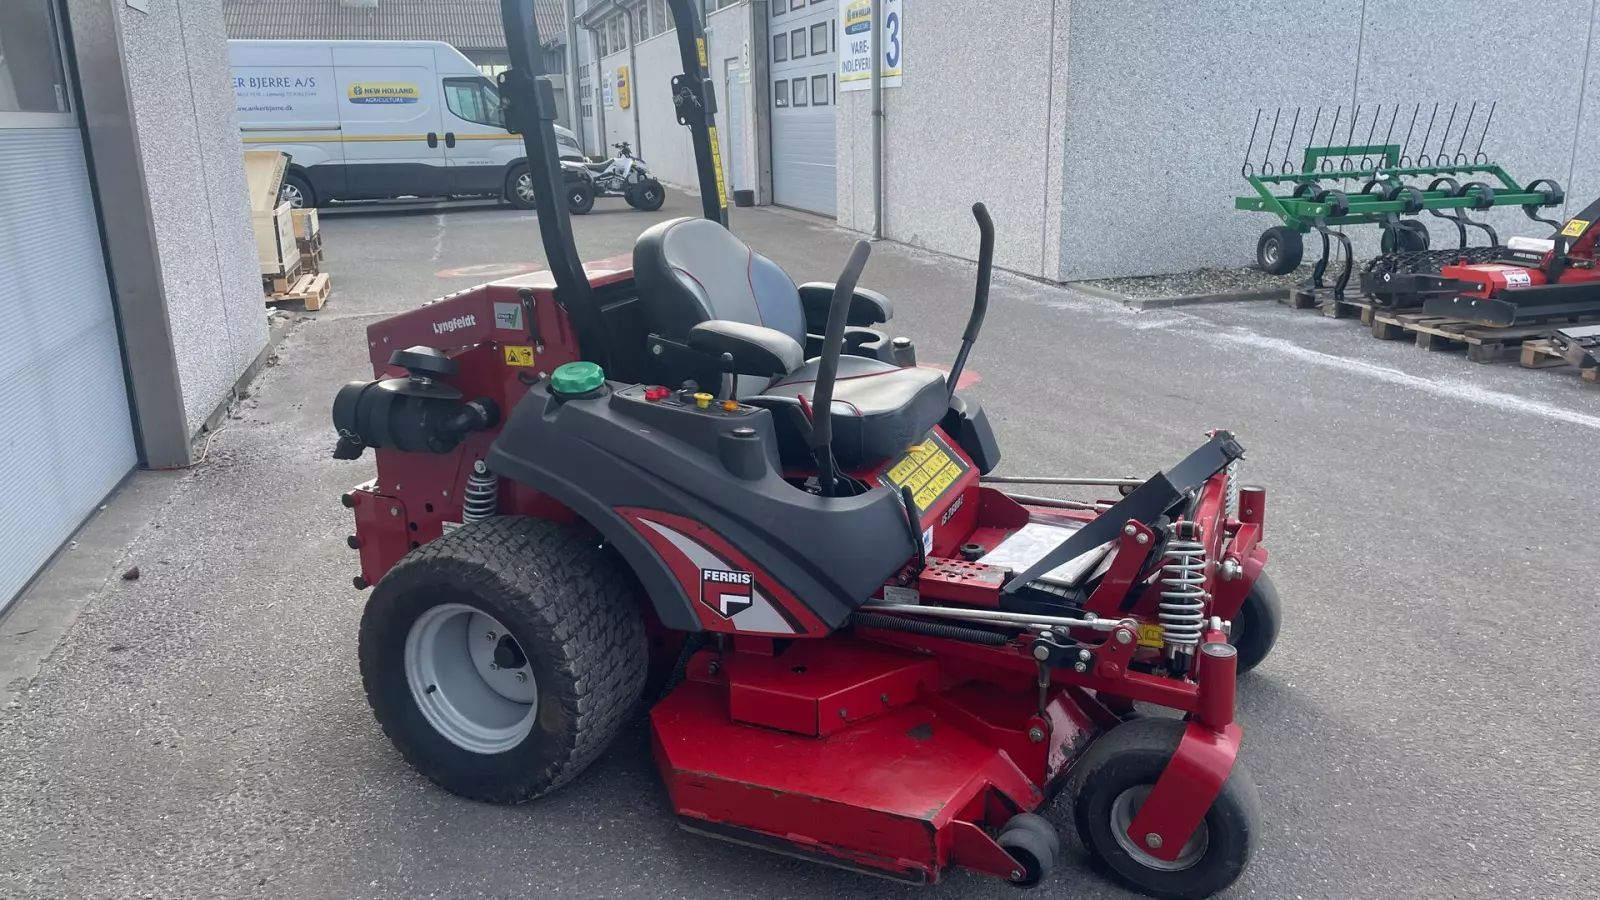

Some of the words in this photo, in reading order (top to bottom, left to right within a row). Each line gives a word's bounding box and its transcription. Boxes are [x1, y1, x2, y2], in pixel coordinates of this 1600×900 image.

[851, 40, 869, 54] VARE-
[886, 12, 900, 68] 3
[249, 77, 291, 89] BJERRE
[294, 77, 316, 88] A/S
[364, 87, 380, 95] NEW
[381, 87, 414, 95] HOLLAND
[432, 314, 476, 334] Lyngfeldt
[703, 570, 751, 584] FERRIS
